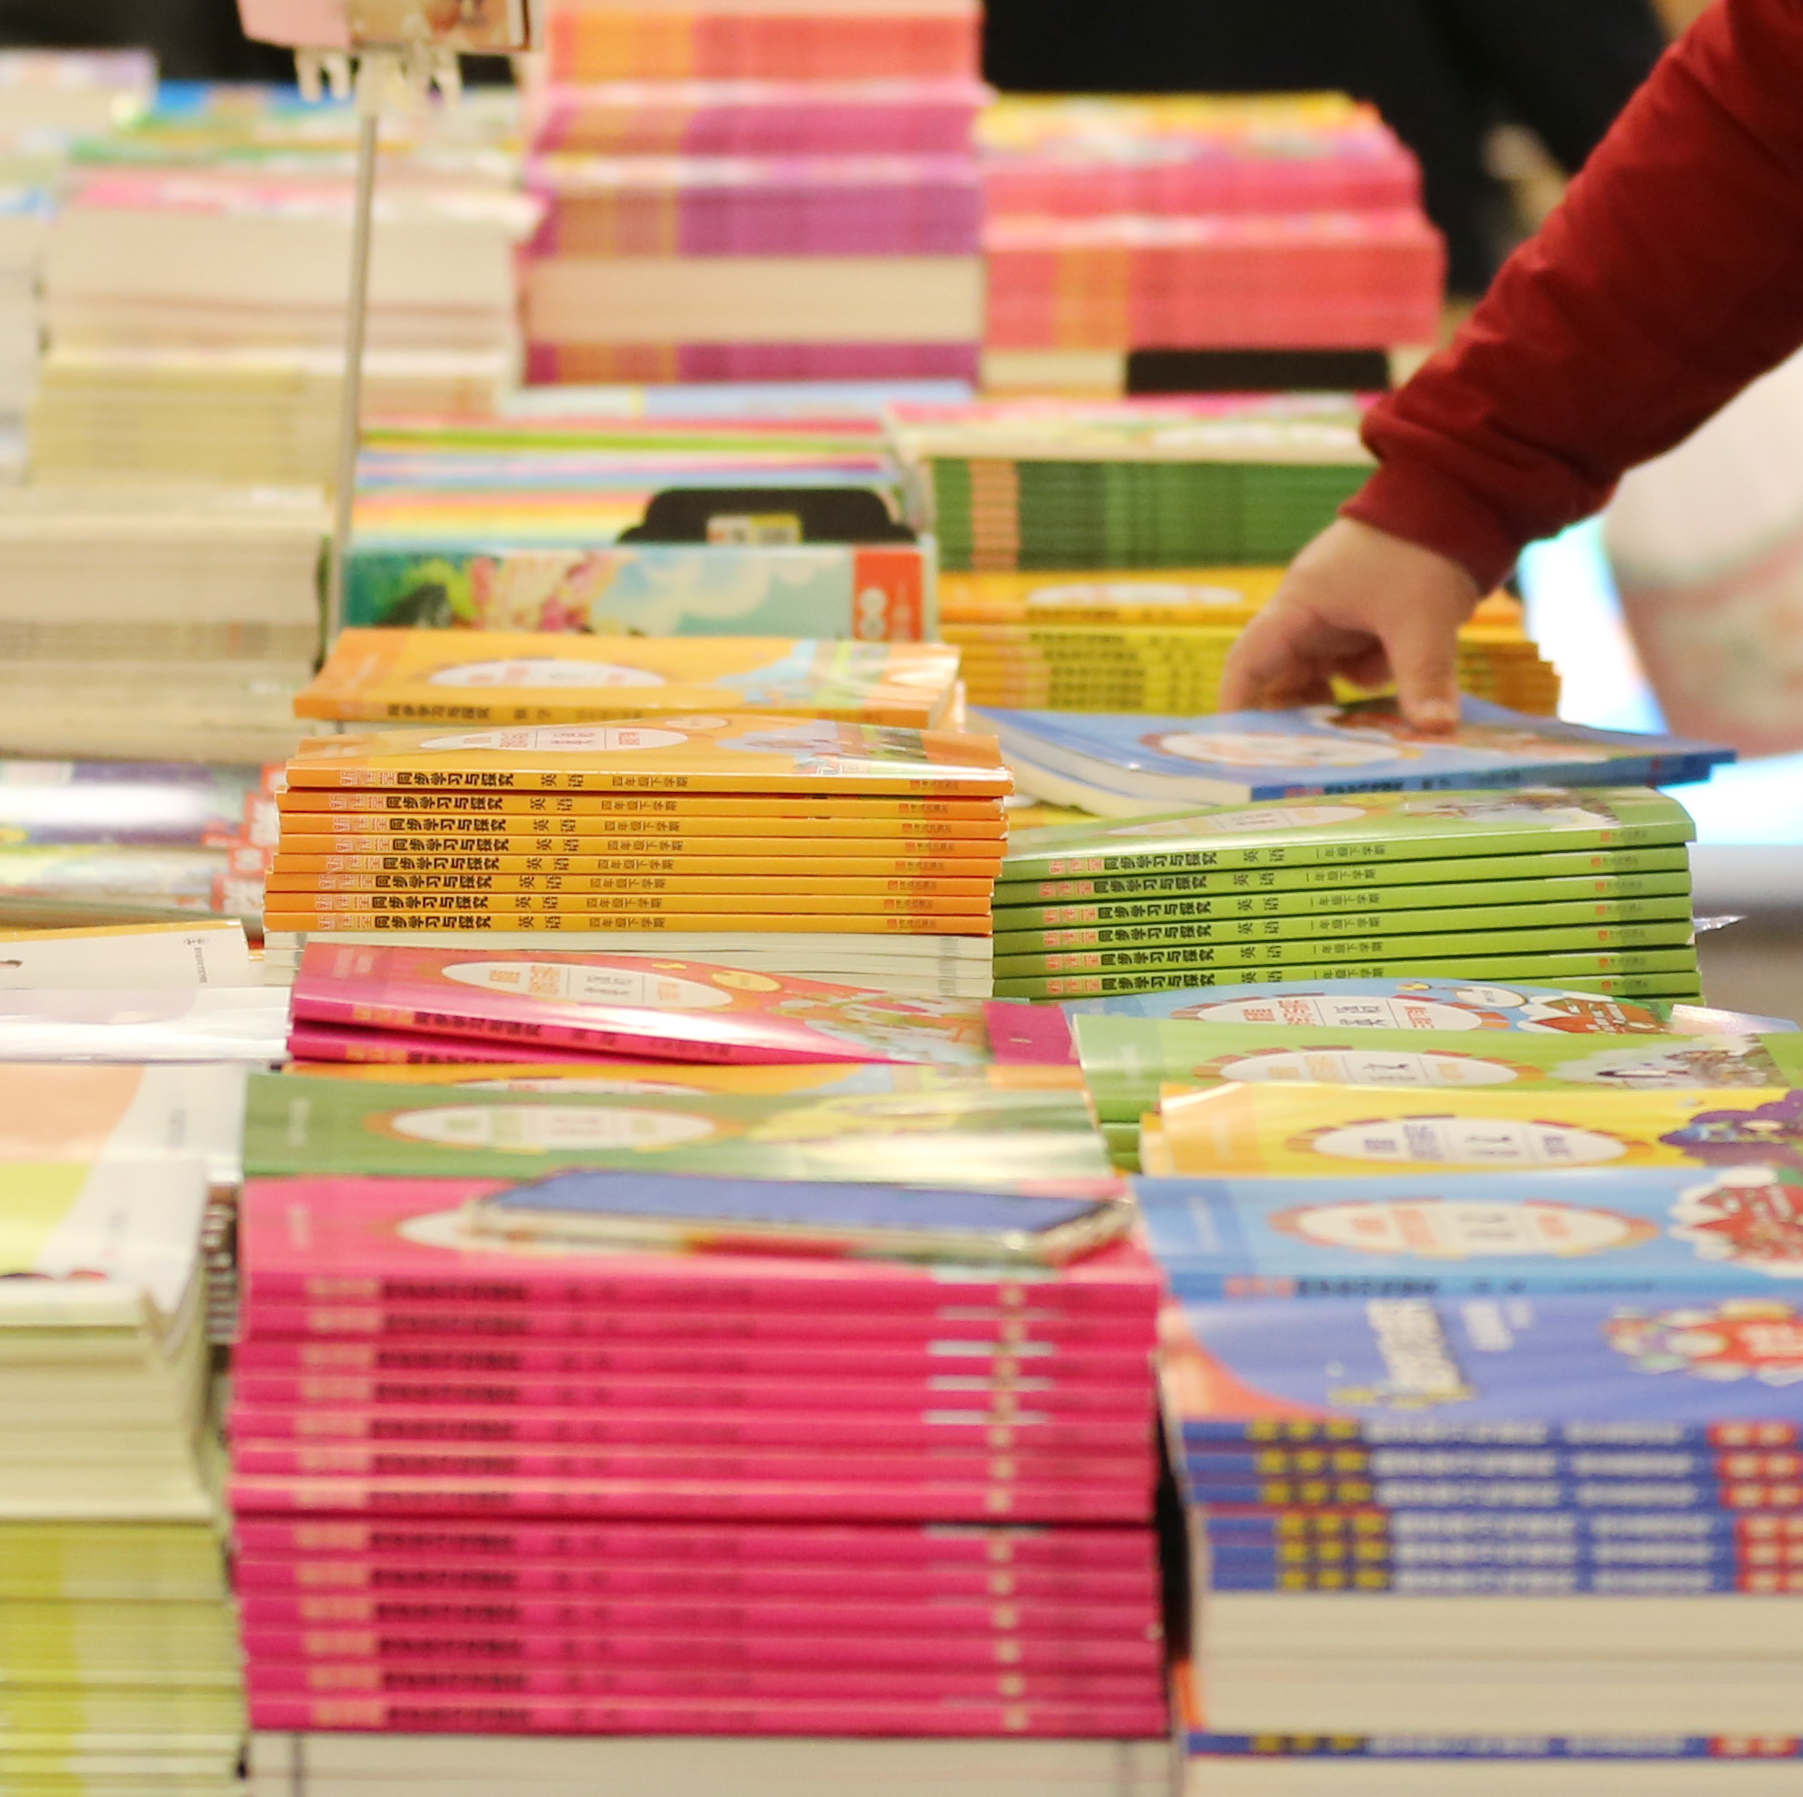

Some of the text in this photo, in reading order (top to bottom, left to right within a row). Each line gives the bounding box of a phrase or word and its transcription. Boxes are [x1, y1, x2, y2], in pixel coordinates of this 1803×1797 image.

[398, 772, 513, 786] 同步学习与探究
[541, 774, 584, 788] 英语
[613, 776, 688, 787] 四年级下学期
[386, 796, 503, 810] 同步学习与探究
[530, 798, 573, 811] 英语
[601, 800, 677, 811] 四年级下学期
[389, 818, 506, 831] 同步学习与探究
[534, 819, 576, 833] 英语
[604, 821, 681, 832] 四年级下学期
[393, 838, 509, 852] 同步学习与探究
[537, 839, 579, 852] 英语
[607, 840, 683, 852] 四年级下学期
[383, 857, 499, 871] 同步学习与探究
[527, 858, 569, 870] 英语
[598, 859, 674, 870] 四年级下学期
[1104, 852, 1217, 871] 同步学习与探究
[1244, 848, 1285, 862] 英语
[376, 875, 492, 888] 同步学习与探究
[519, 875, 561, 889] 英语
[590, 878, 665, 889] 四年级下学期
[1094, 876, 1207, 894] 同步学习与探究
[1234, 872, 1275, 886] 英语
[372, 896, 488, 909] 同步学习与探究
[515, 896, 557, 910] 英语
[586, 898, 662, 908] 四年级下学期
[1098, 901, 1211, 920] 同步学习与探究
[1238, 898, 1279, 912] 英语
[375, 916, 491, 928] 同步学习与探究
[519, 916, 561, 928] 英语
[589, 917, 665, 928] 四年级下学期
[1098, 924, 1211, 943] 同步学习与探究
[1238, 921, 1279, 935] 英语
[1101, 949, 1214, 966] 同步学习与探究
[1241, 945, 1282, 959] 英语
[1102, 974, 1215, 991] 同步学习与探究
